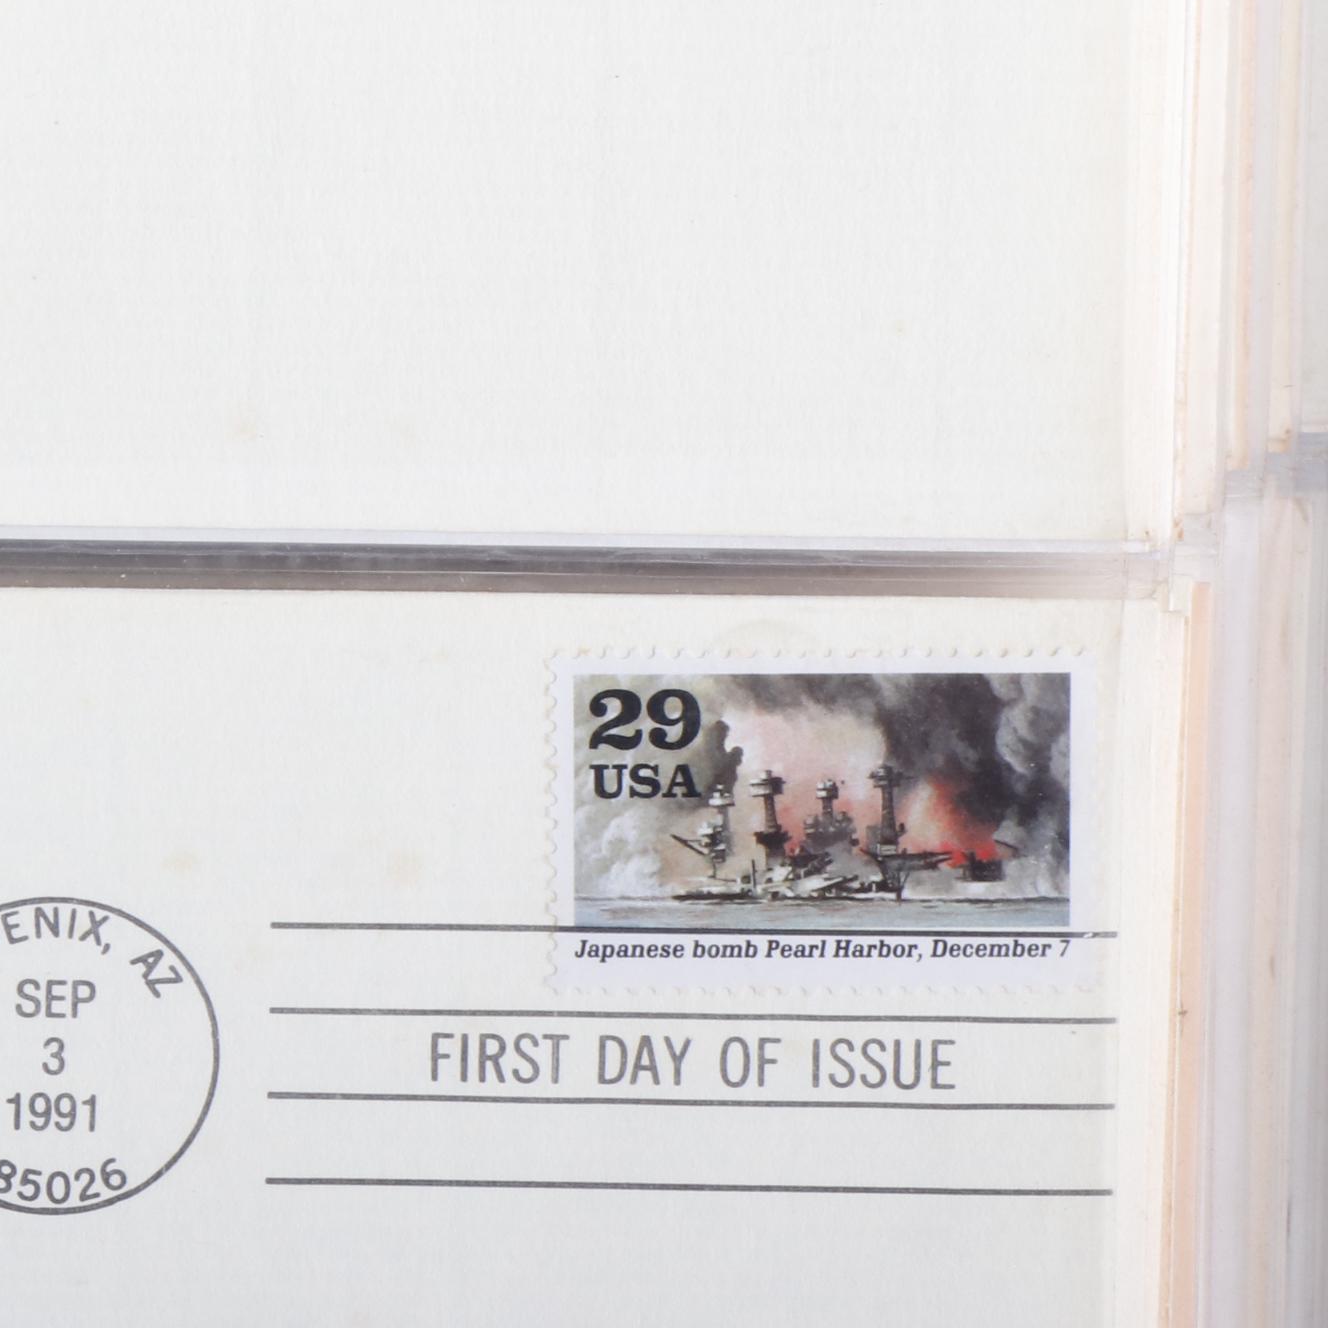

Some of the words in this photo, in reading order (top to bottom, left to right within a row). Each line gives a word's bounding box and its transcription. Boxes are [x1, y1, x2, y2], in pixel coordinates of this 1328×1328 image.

[589, 688, 701, 751] 29
[589, 763, 702, 799] USA
[575, 939, 685, 963] Japanese
[692, 939, 758, 959] bomb
[764, 939, 826, 959] Pearl
[833, 939, 923, 962] Harbor,
[930, 939, 1052, 958] December
[1059, 939, 1072, 958] 7
[129, 948, 184, 999] AZ
[15, 979, 97, 1019] SEP
[42, 1037, 65, 1076] 3
[429, 1032, 570, 1084] FIRST
[597, 1034, 692, 1086] DAY
[718, 1036, 782, 1088] OF
[810, 1038, 957, 1090] ISSUE
[6, 1092, 97, 1132] 1991
